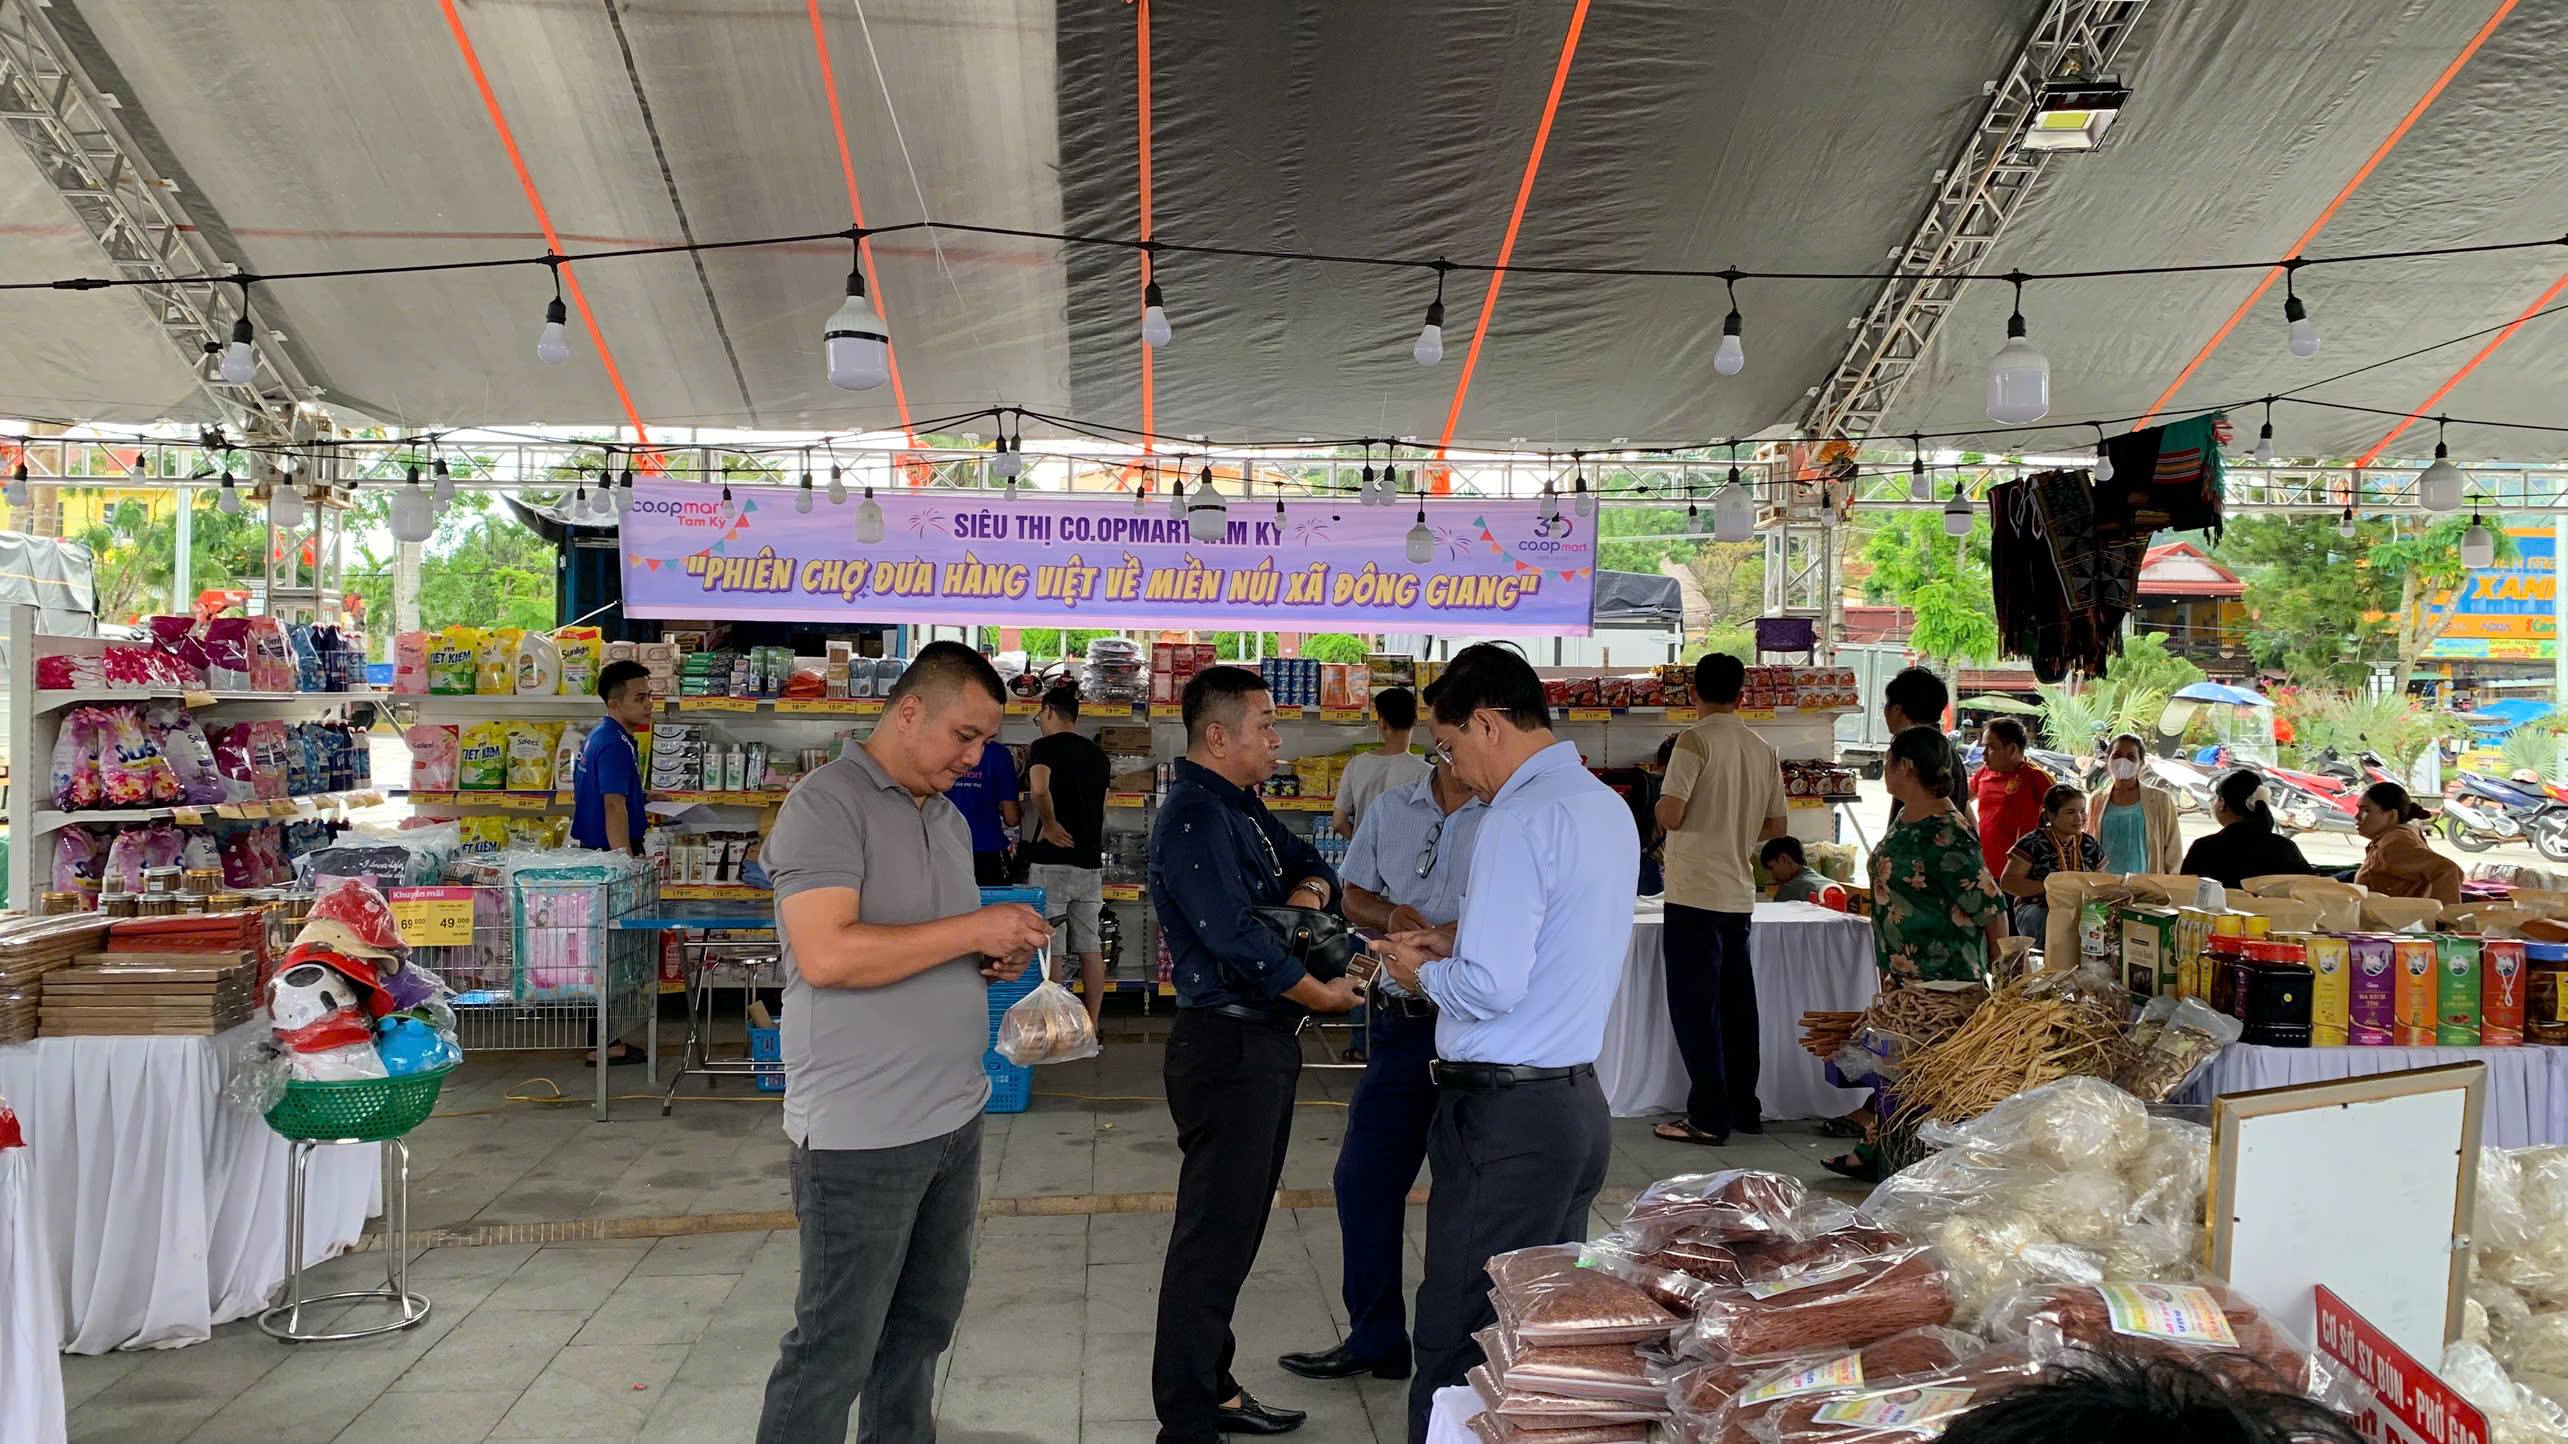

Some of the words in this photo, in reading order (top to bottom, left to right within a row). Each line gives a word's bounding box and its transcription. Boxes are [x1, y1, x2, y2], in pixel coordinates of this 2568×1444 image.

[632, 500, 725, 517] co.opmar
[677, 516, 706, 527] Tam
[954, 509, 1008, 539] SIÊU
[1016, 514, 1051, 546] THỊ
[1059, 516, 1191, 544] CO.OPMART
[801, 558, 873, 603] CHỢ
[872, 555, 936, 598] ĐƯA
[941, 549, 1030, 600] HÀNG
[1035, 553, 1102, 608] VIỆT
[1105, 550, 1143, 601] VỀ
[1144, 551, 1226, 603] MIỀN
[1227, 554, 1283, 606] NÚI
[1283, 561, 1331, 607] XÃ
[1332, 561, 1421, 610] ĐÔNG
[440, 918, 455, 928] 49
[2321, 1309, 2337, 1350] CƠ
[2339, 1319, 2355, 1366] SỞ
[2357, 1339, 2374, 1386] SX
[2376, 1356, 2405, 1410] BÚN
[2415, 1387, 2445, 1444] PHỞ
